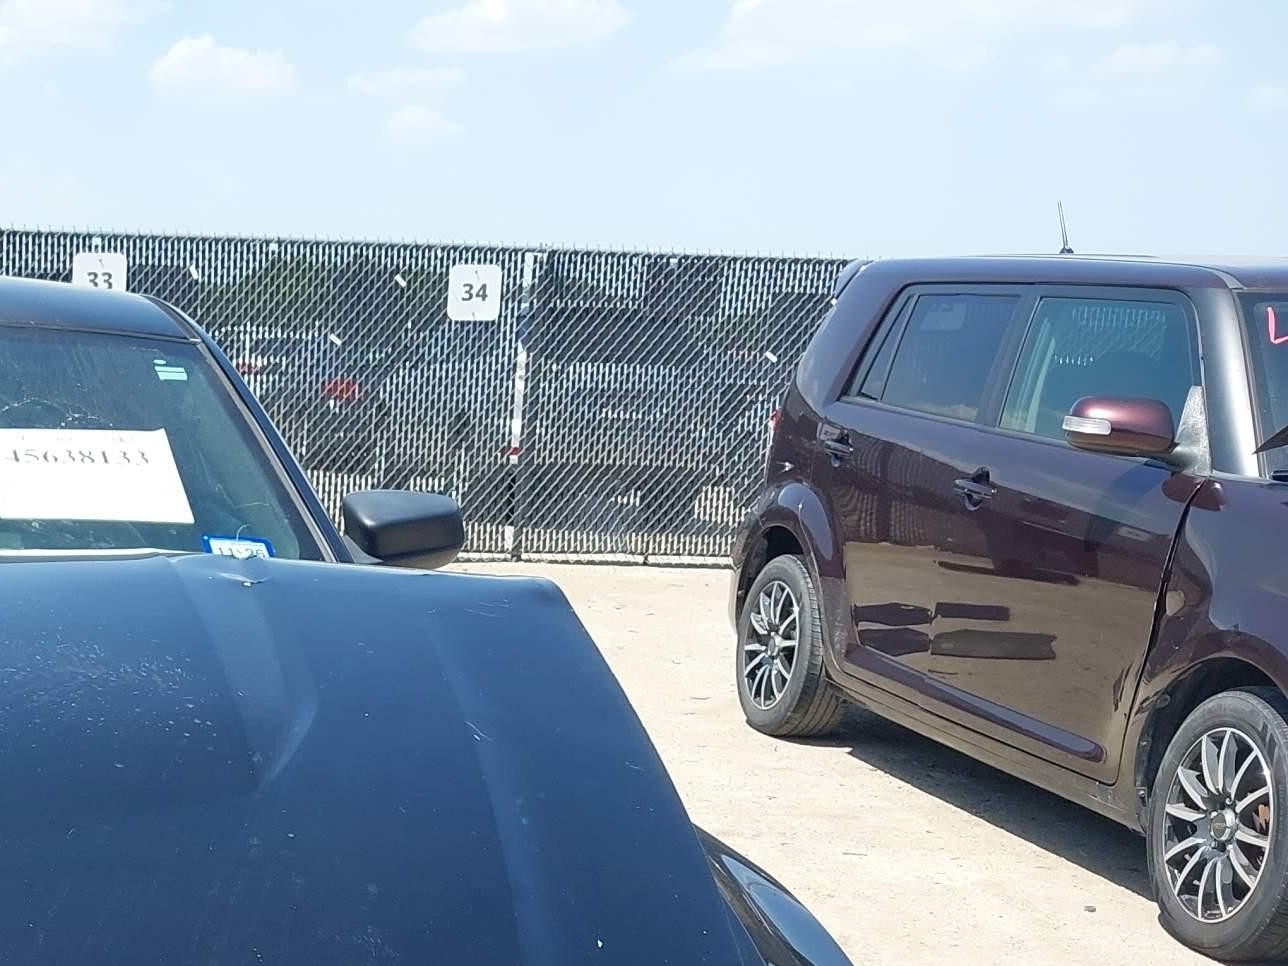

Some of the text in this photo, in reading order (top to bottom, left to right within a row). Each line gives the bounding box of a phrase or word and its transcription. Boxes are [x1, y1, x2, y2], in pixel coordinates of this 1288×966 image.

[87, 271, 113, 289] 33
[461, 283, 488, 301] 34
[6, 448, 150, 465] 45638133
